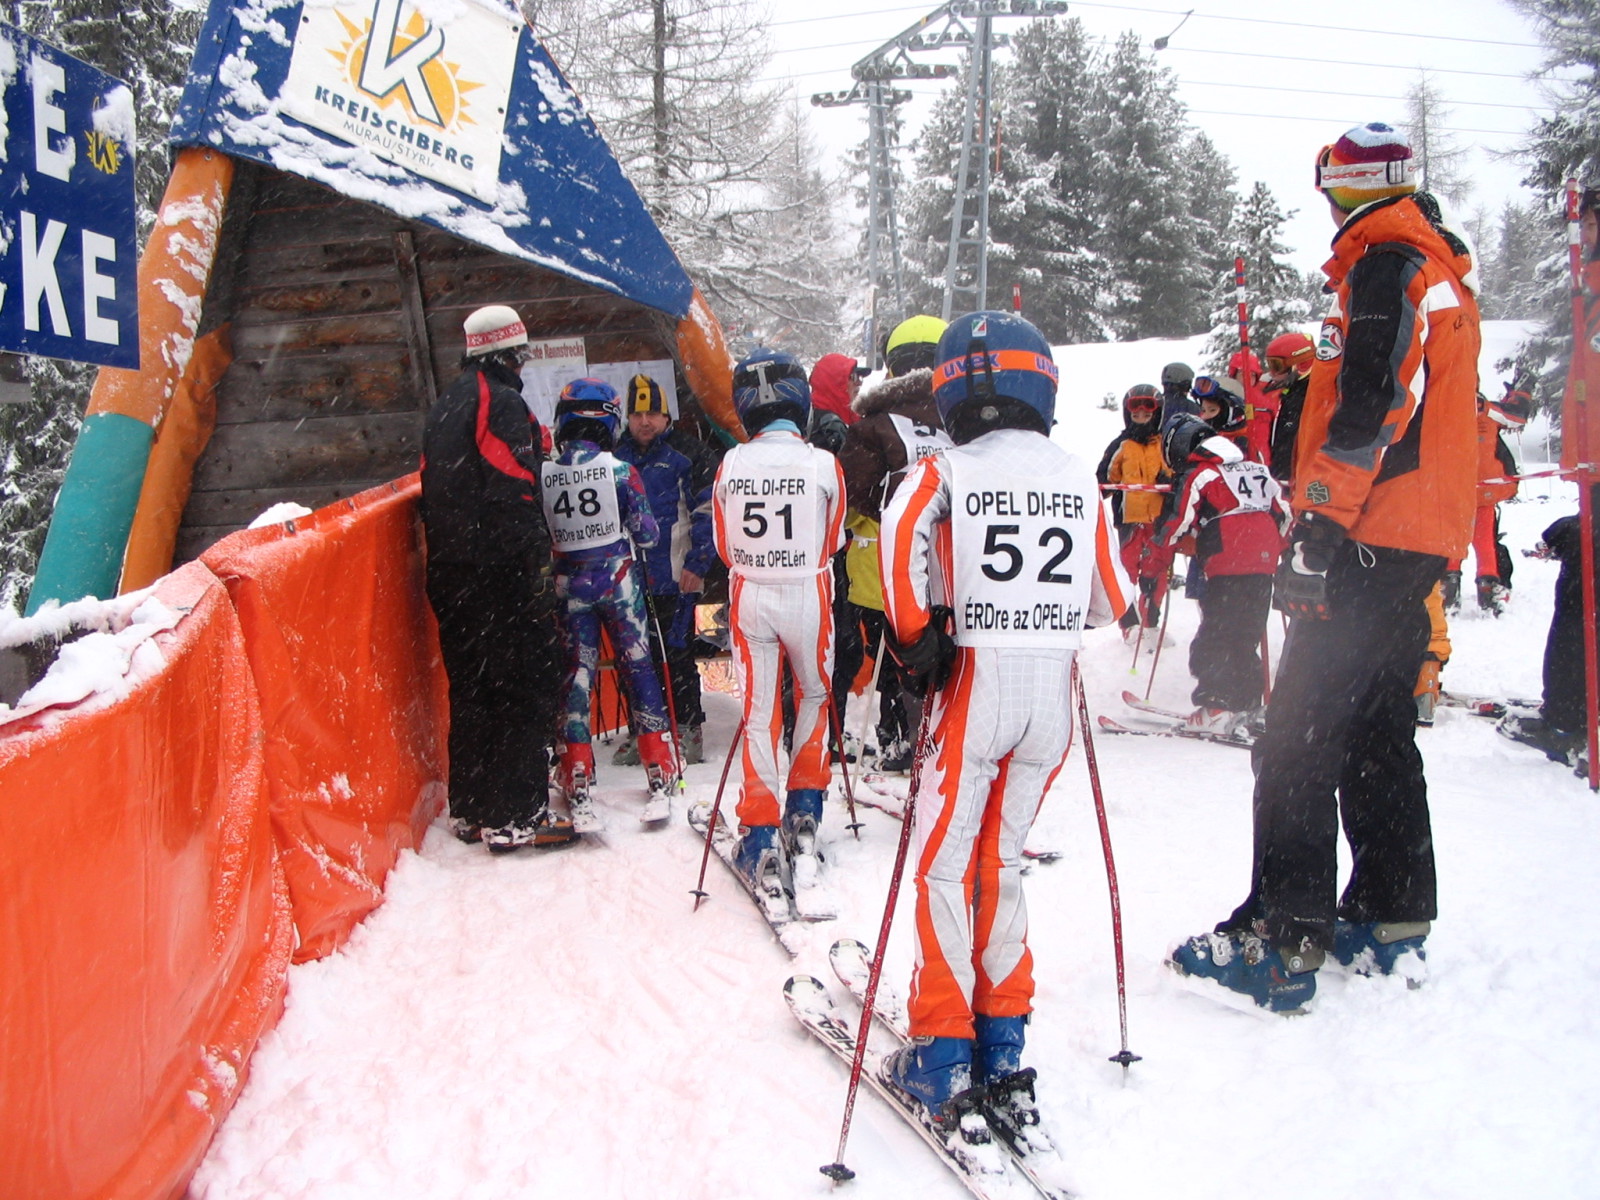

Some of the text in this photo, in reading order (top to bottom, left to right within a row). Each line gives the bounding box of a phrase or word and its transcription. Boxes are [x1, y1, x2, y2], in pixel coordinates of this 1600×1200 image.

[315, 85, 474, 171] KREISCHBERG
[343, 120, 435, 168] MURAU/STYRI
[0, 210, 120, 346] KE
[944, 352, 1001, 379] uvex
[545, 467, 607, 488] OPEL DI-FER
[728, 479, 805, 496] OPEL DI-FER
[1238, 475, 1268, 499] 47
[553, 488, 601, 518] 48
[966, 491, 1084, 520] OPEL DI-FER
[576, 530, 585, 540] az
[585, 521, 615, 538] OPELért
[742, 502, 793, 540] 51
[756, 554, 766, 567] az
[768, 550, 806, 568] OPELért
[981, 525, 1073, 584] 52
[965, 596, 1081, 631] ÉRDre az OPELért
[818, 1012, 857, 1051] HEA
[900, 1079, 936, 1097] LANGE
